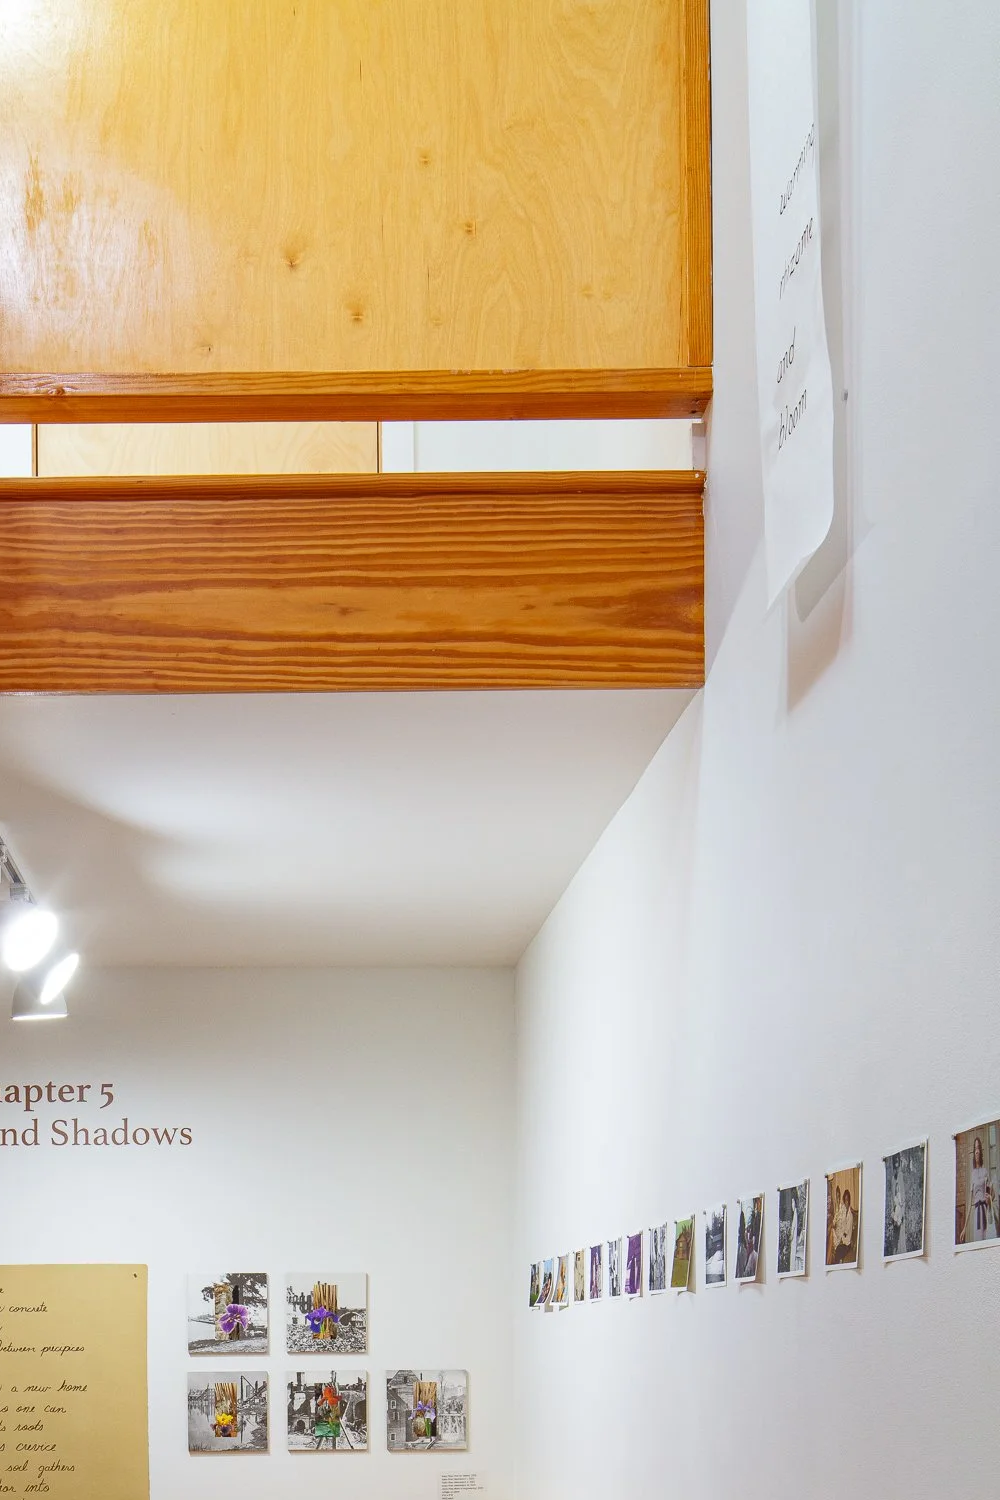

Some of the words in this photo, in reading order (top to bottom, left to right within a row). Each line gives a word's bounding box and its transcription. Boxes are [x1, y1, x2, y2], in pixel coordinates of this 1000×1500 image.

[777, 325, 796, 383] and
[778, 388, 807, 450] bloom
[99, 1084, 114, 1109] 5
[51, 1118, 193, 1147] Shadows
[9, 1302, 48, 1313] concrete
[11, 1384, 18, 1393] a
[24, 1385, 51, 1393] new
[57, 1380, 87, 1393] home
[16, 1404, 35, 1413] one
[44, 1403, 67, 1414] can
[14, 1420, 44, 1432] roots
[16, 1442, 57, 1453] crevice
[5, 1460, 29, 1473] soil
[38, 1459, 75, 1479] gathers
[24, 1478, 50, 1493] into
